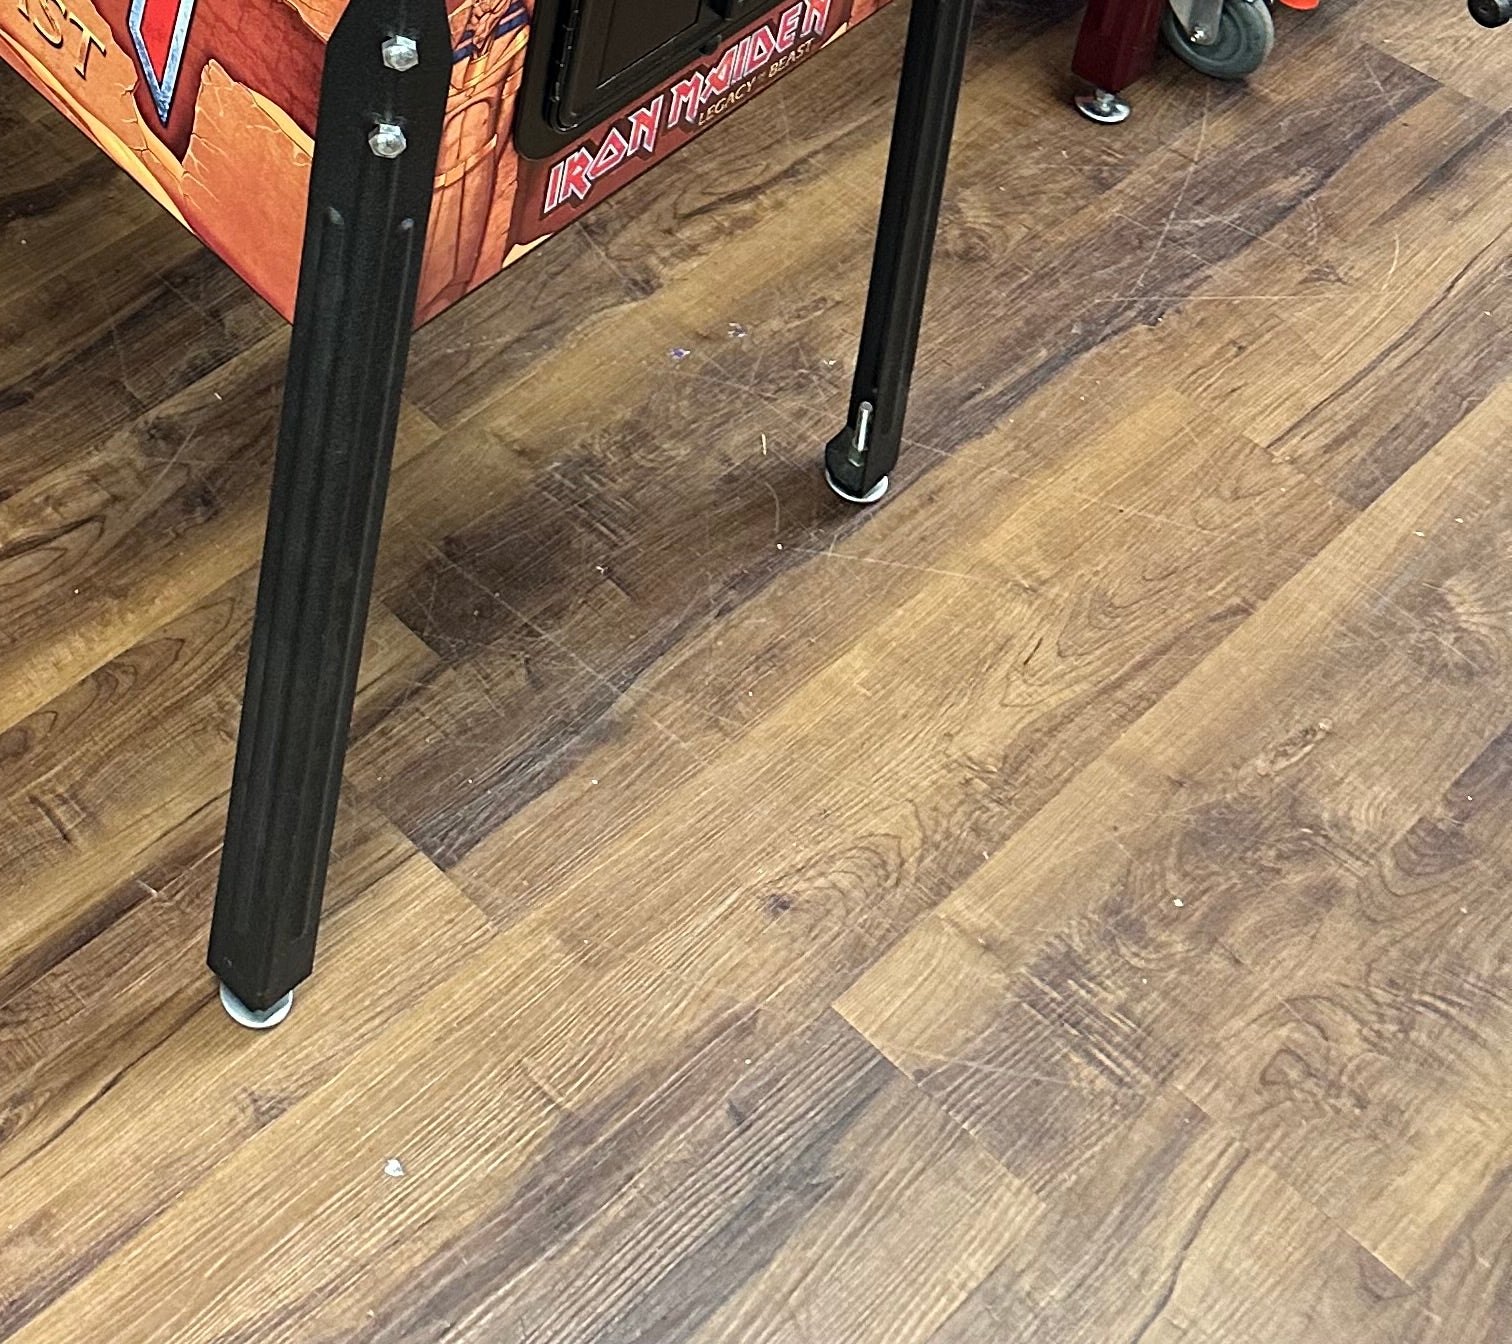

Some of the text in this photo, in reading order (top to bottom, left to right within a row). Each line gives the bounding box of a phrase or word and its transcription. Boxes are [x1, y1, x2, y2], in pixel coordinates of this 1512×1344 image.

[698, 38, 814, 126] LEGACY BEAST
[543, 95, 664, 214] IRON
